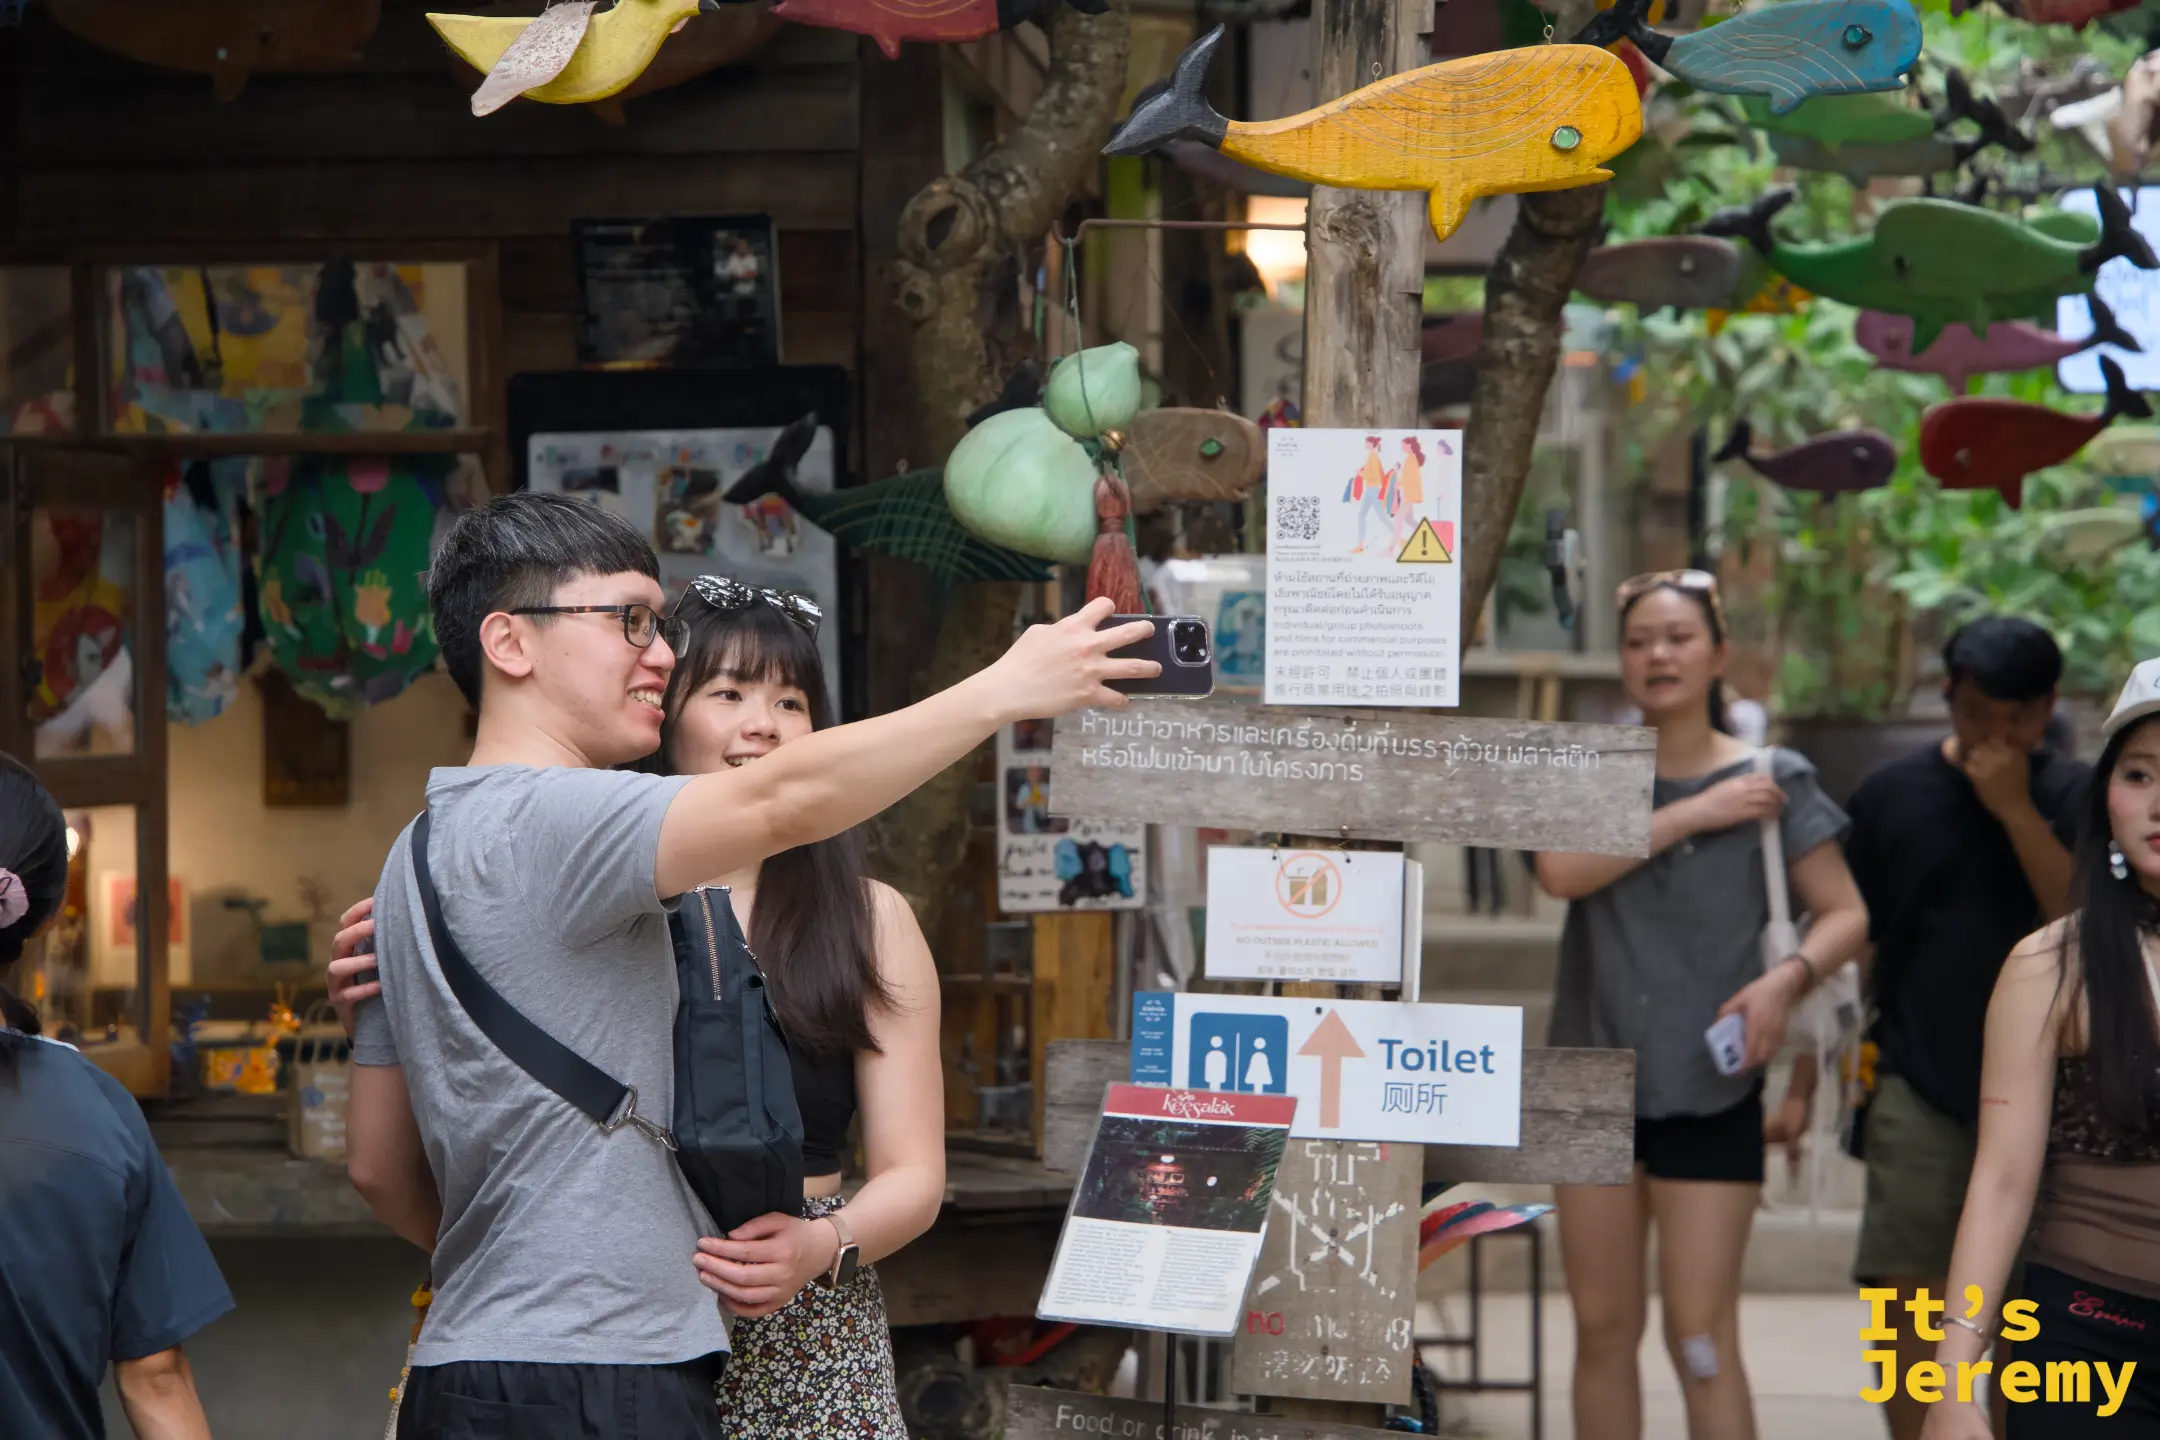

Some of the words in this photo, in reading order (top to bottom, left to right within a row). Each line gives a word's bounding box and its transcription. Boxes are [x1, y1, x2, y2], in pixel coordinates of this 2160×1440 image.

[1359, 621, 1424, 632] photoshoots
[1273, 634, 1293, 643] and
[1321, 635, 1336, 643] for
[1338, 635, 1398, 645] commercial
[1399, 636, 1447, 646] purposes
[1273, 648, 1289, 657] are
[1346, 648, 1385, 658] without
[1235, 936, 1250, 945] NO
[1333, 938, 1379, 949] ALLOWED
[1378, 1039, 1495, 1075] Toilet
[1381, 1081, 1448, 1115] 厕所
[1247, 1310, 1285, 1336] no
[1055, 1404, 1115, 1435] Food
[1122, 1419, 1147, 1438] or
